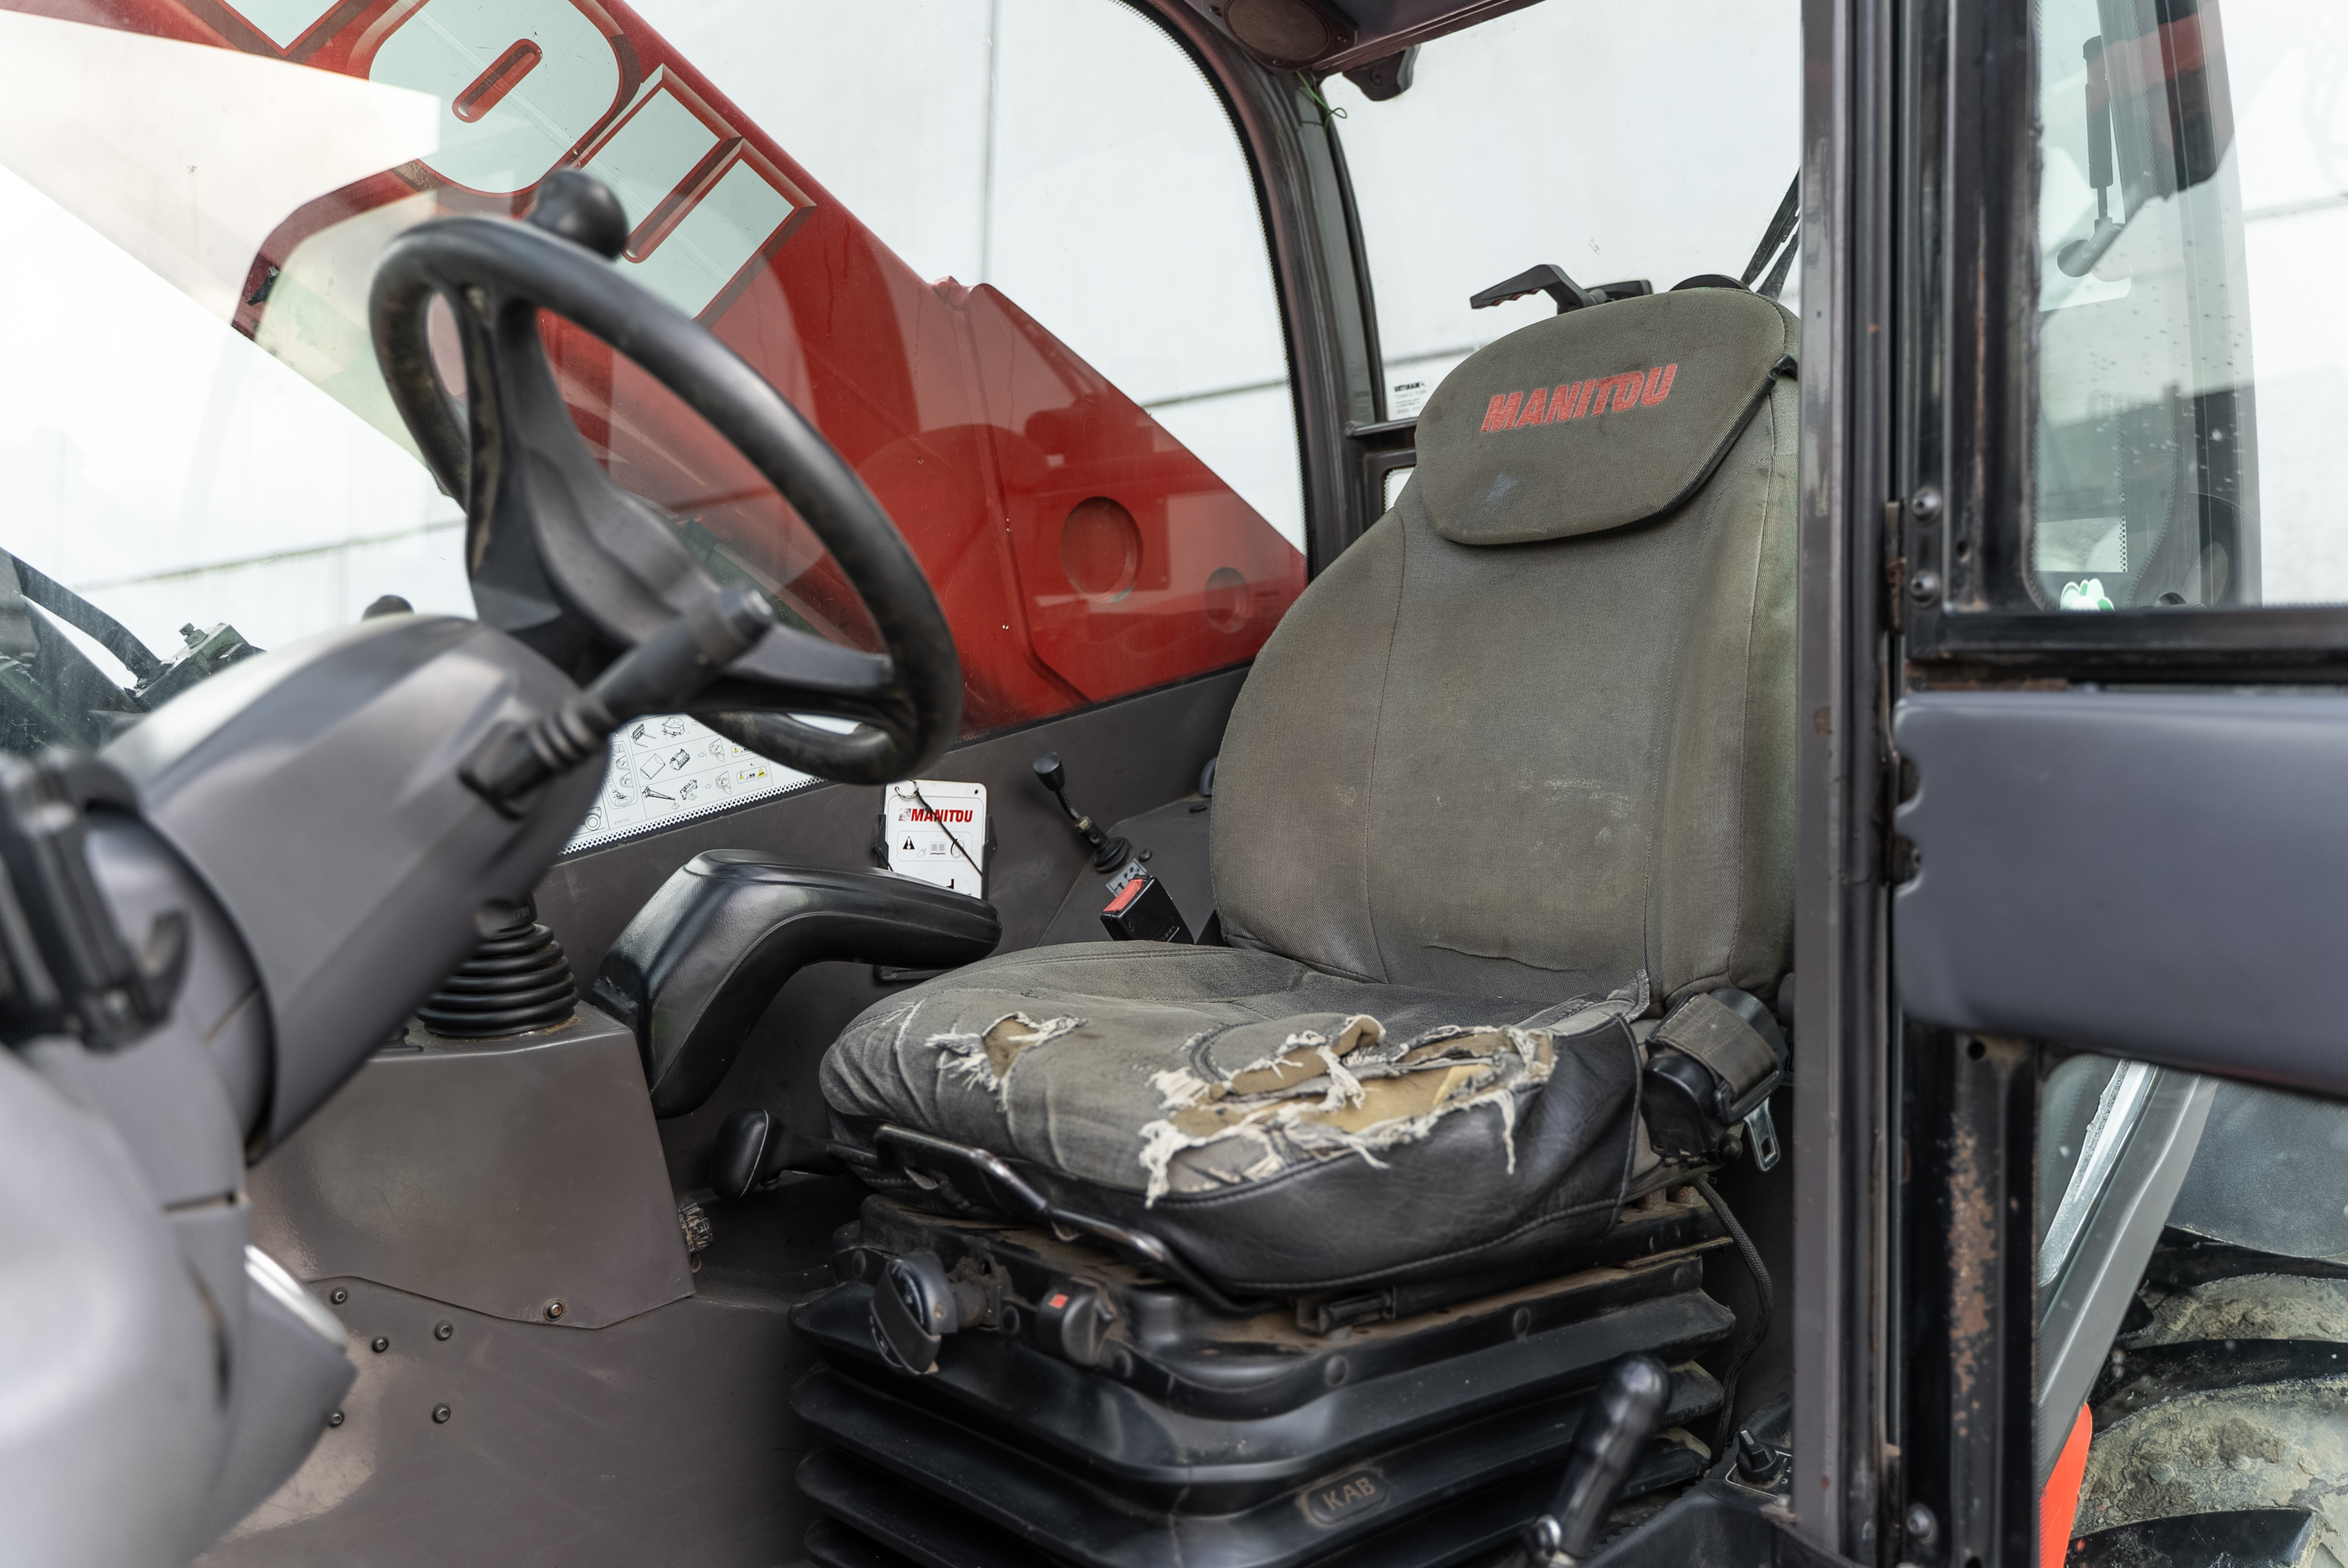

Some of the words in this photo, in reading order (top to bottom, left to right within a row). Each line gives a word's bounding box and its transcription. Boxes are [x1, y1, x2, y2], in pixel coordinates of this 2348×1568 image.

[179, 0, 817, 329] OU
[1480, 363, 1678, 433] MANITOU
[910, 808, 973, 823] MANITOU
[512, 906, 530, 920] ITOU
[1322, 1477, 1376, 1511] KAB
